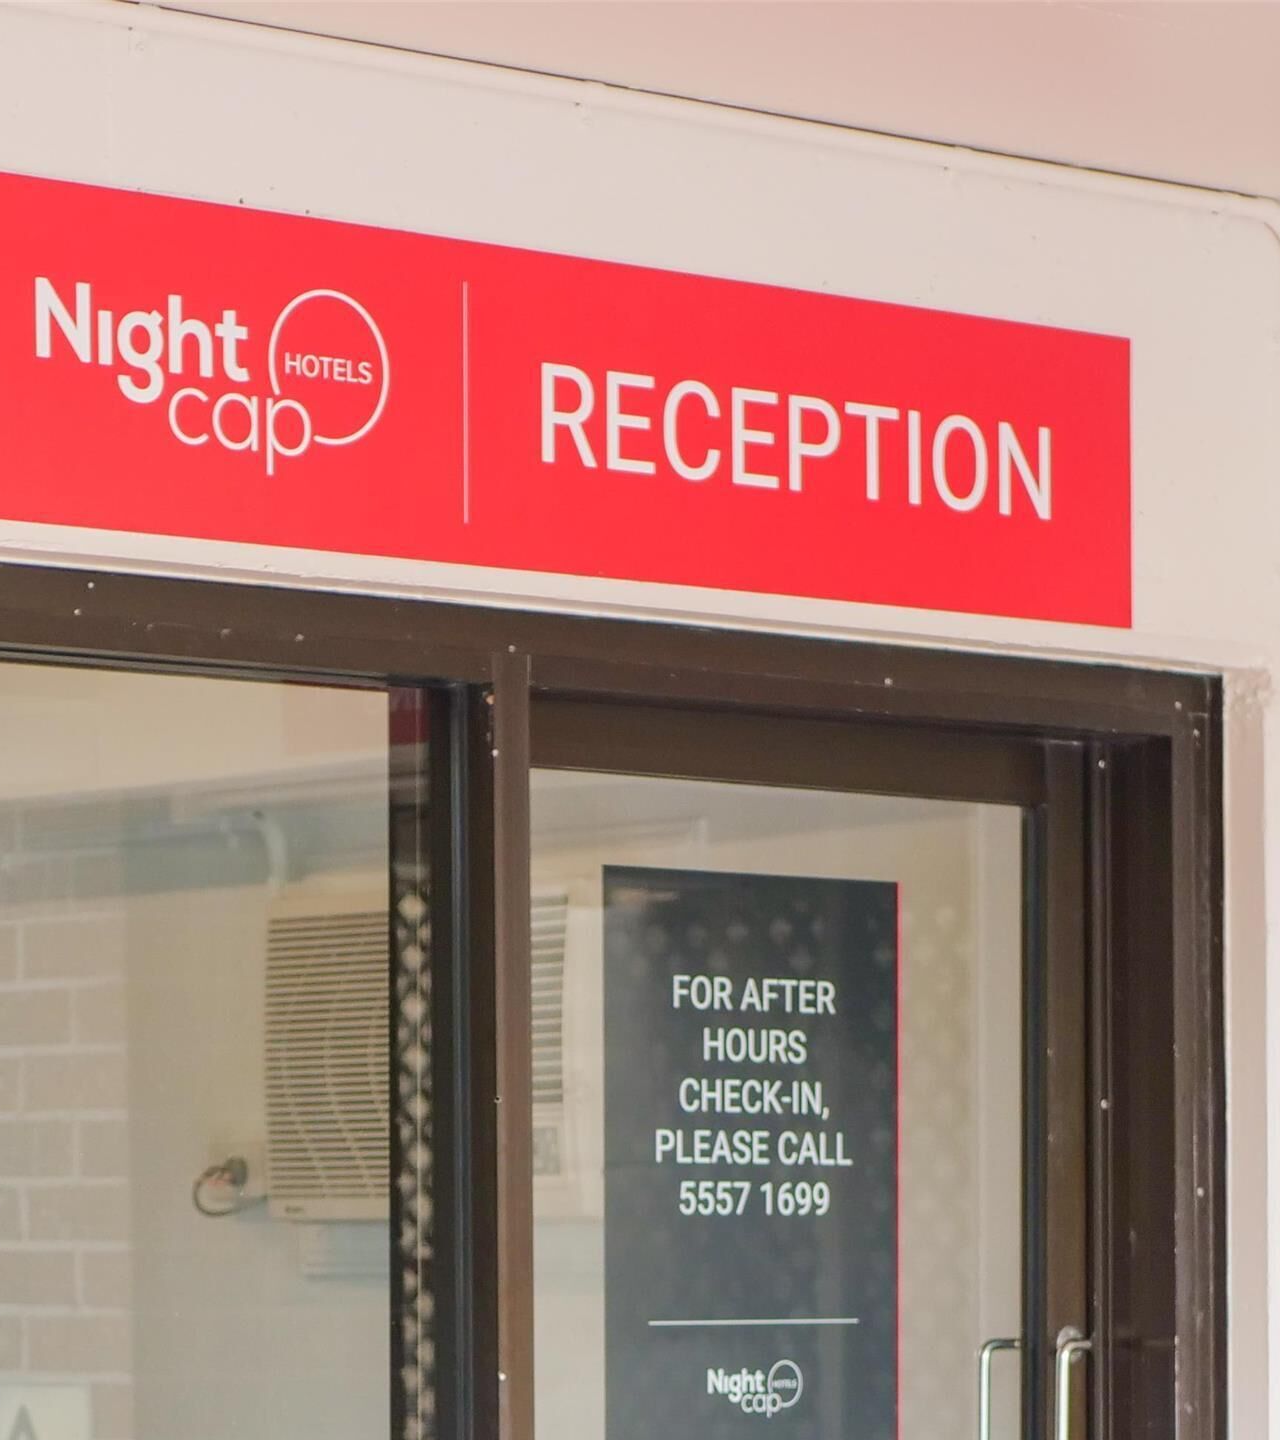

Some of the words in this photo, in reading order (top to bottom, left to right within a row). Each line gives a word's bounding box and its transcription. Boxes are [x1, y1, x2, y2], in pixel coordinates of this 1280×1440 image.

[34, 276, 250, 405] Night
[284, 352, 373, 385] HOTELS
[167, 384, 312, 476] cap
[541, 362, 1052, 520] RECEPTION
[673, 974, 733, 1011] FOR
[739, 977, 836, 1015] AFTER
[703, 1027, 807, 1065] HOURS
[679, 1077, 830, 1120] CHECK-IN,
[655, 1128, 770, 1165] PLEASE
[777, 1130, 853, 1166] CALL
[679, 1180, 751, 1216] 5557
[760, 1181, 830, 1216] 1699
[706, 1367, 766, 1403] Night
[740, 1392, 782, 1418] cap
